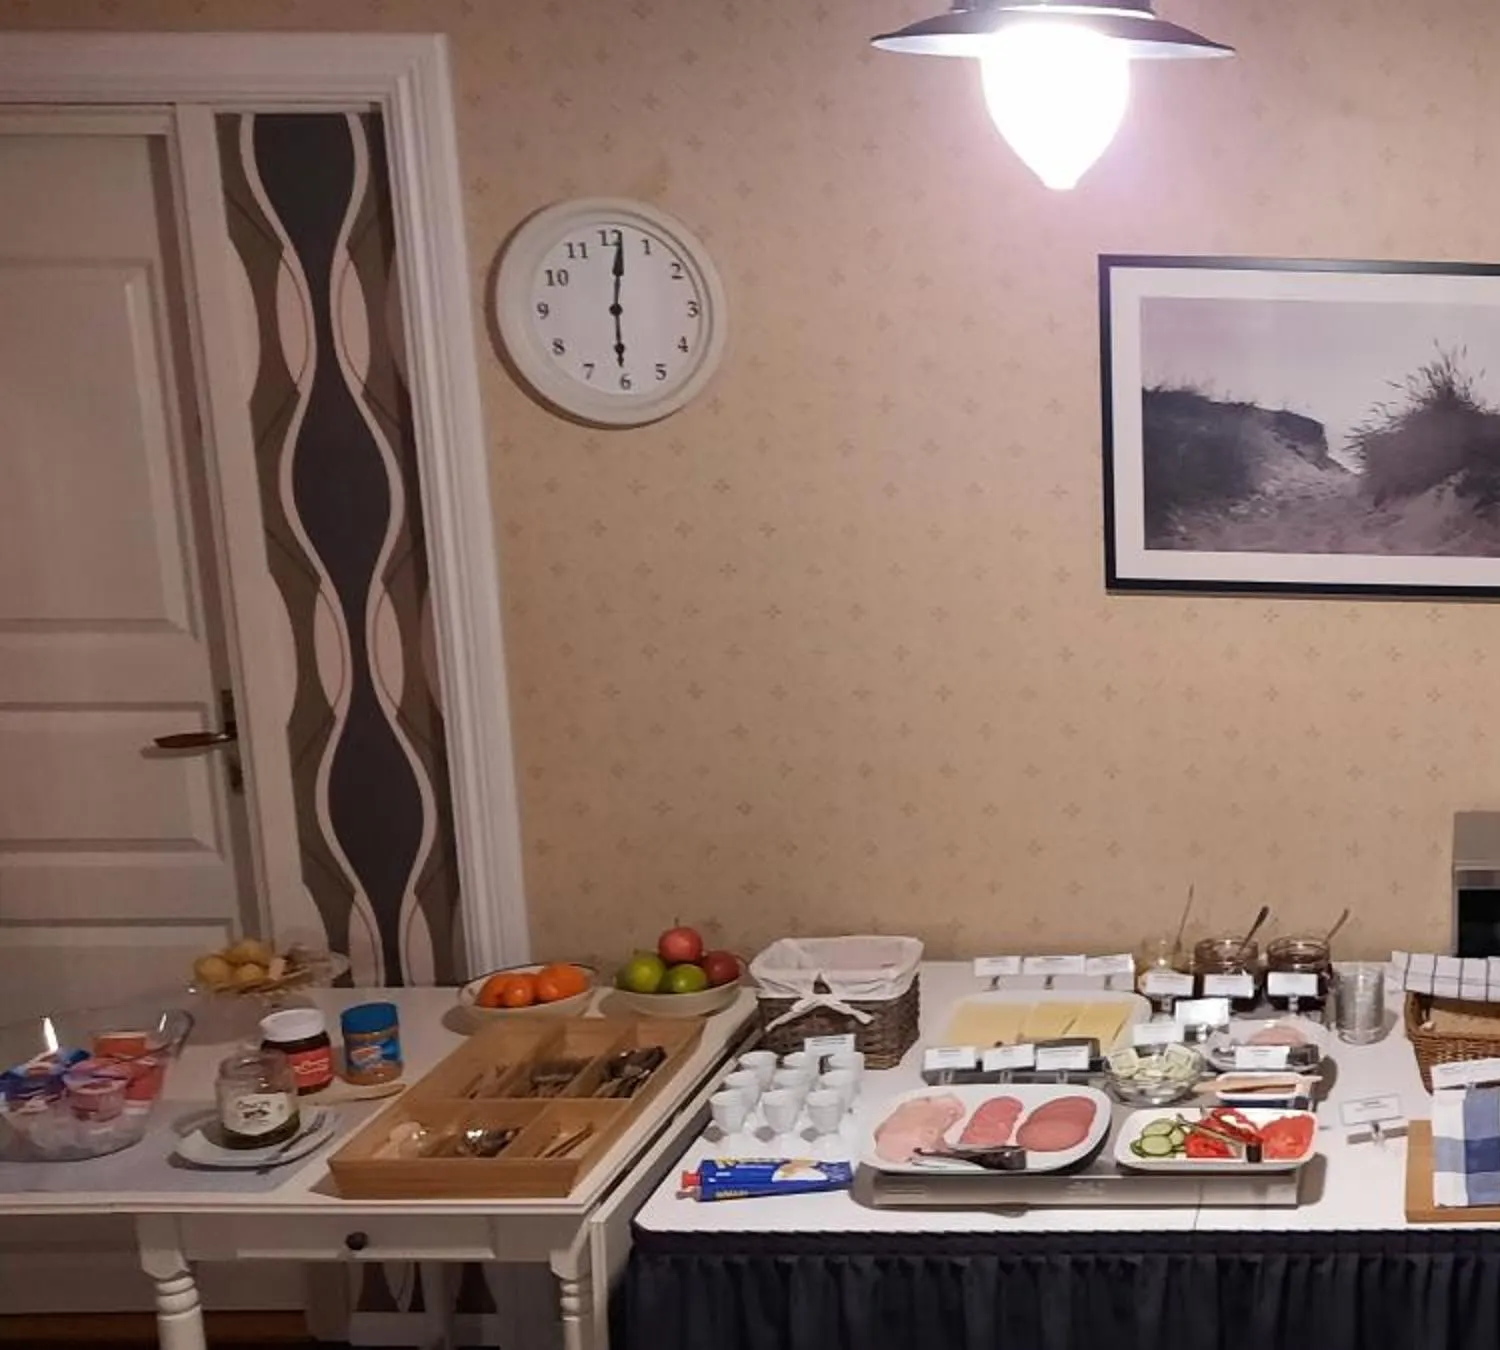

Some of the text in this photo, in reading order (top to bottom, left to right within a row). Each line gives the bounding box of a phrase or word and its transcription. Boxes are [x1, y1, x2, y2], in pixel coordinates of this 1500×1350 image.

[564, 242, 588, 259] 11
[641, 239, 652, 255] 1
[545, 269, 569, 287] 10
[671, 263, 683, 280] 2
[537, 302, 549, 319] 9
[687, 301, 699, 318] 3
[552, 338, 565, 356] 8
[677, 336, 689, 353] 4
[583, 363, 595, 380] 7
[655, 363, 667, 380] 5
[620, 374, 631, 390] 6
